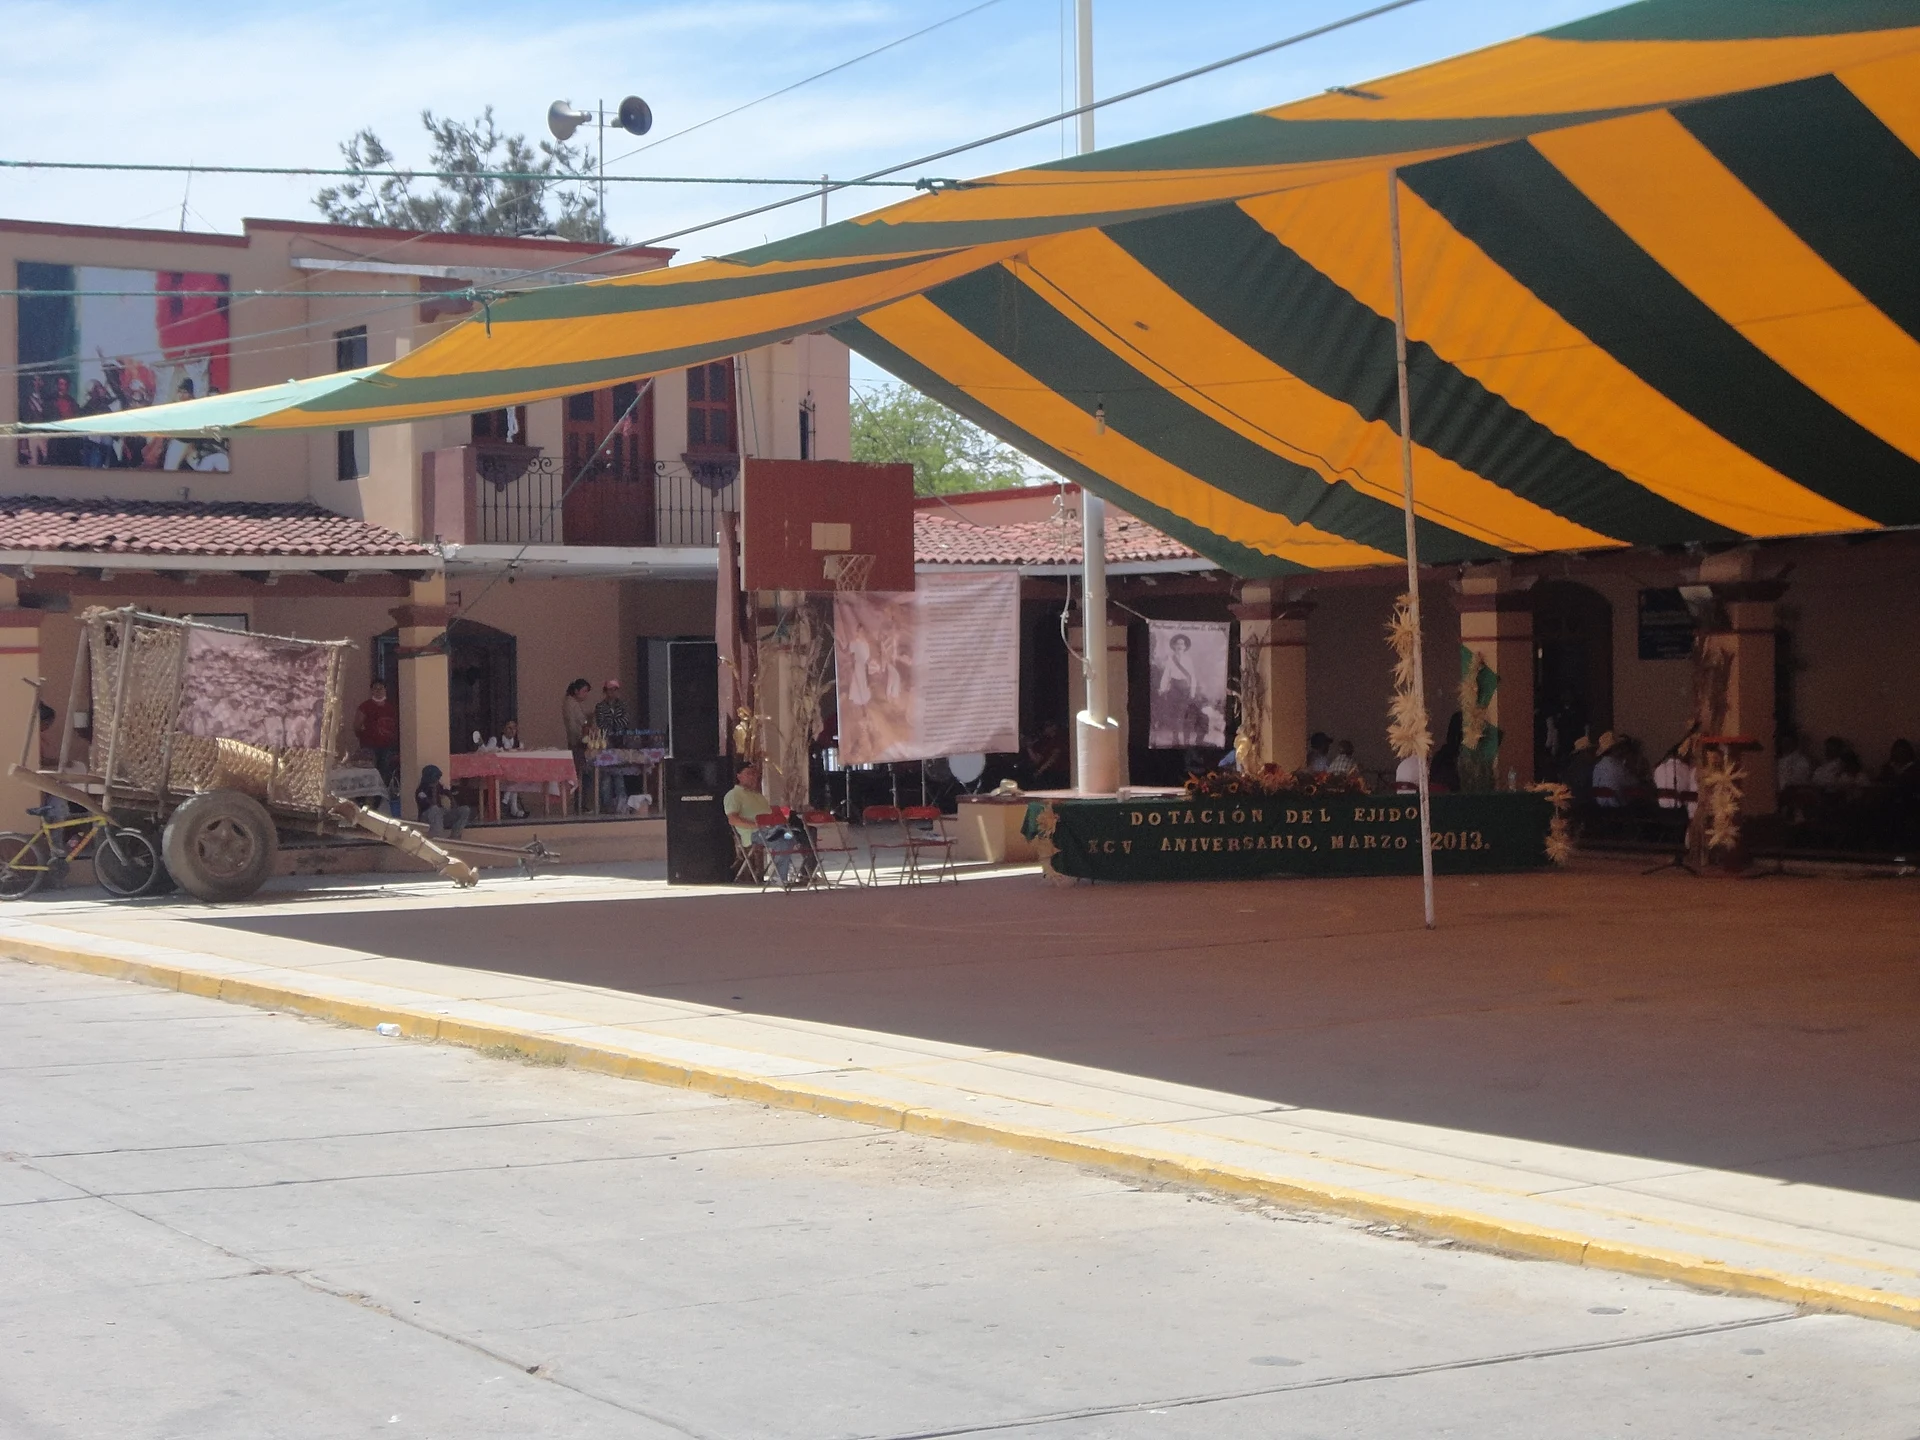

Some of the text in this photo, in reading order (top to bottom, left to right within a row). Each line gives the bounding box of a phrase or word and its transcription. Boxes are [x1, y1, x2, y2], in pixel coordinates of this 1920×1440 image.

[1131, 804, 1418, 826] DOTACIÓN DEL EJIDO
[1160, 835, 1318, 852] ANIVERSARIO,
[1331, 835, 1408, 849] MARZO
